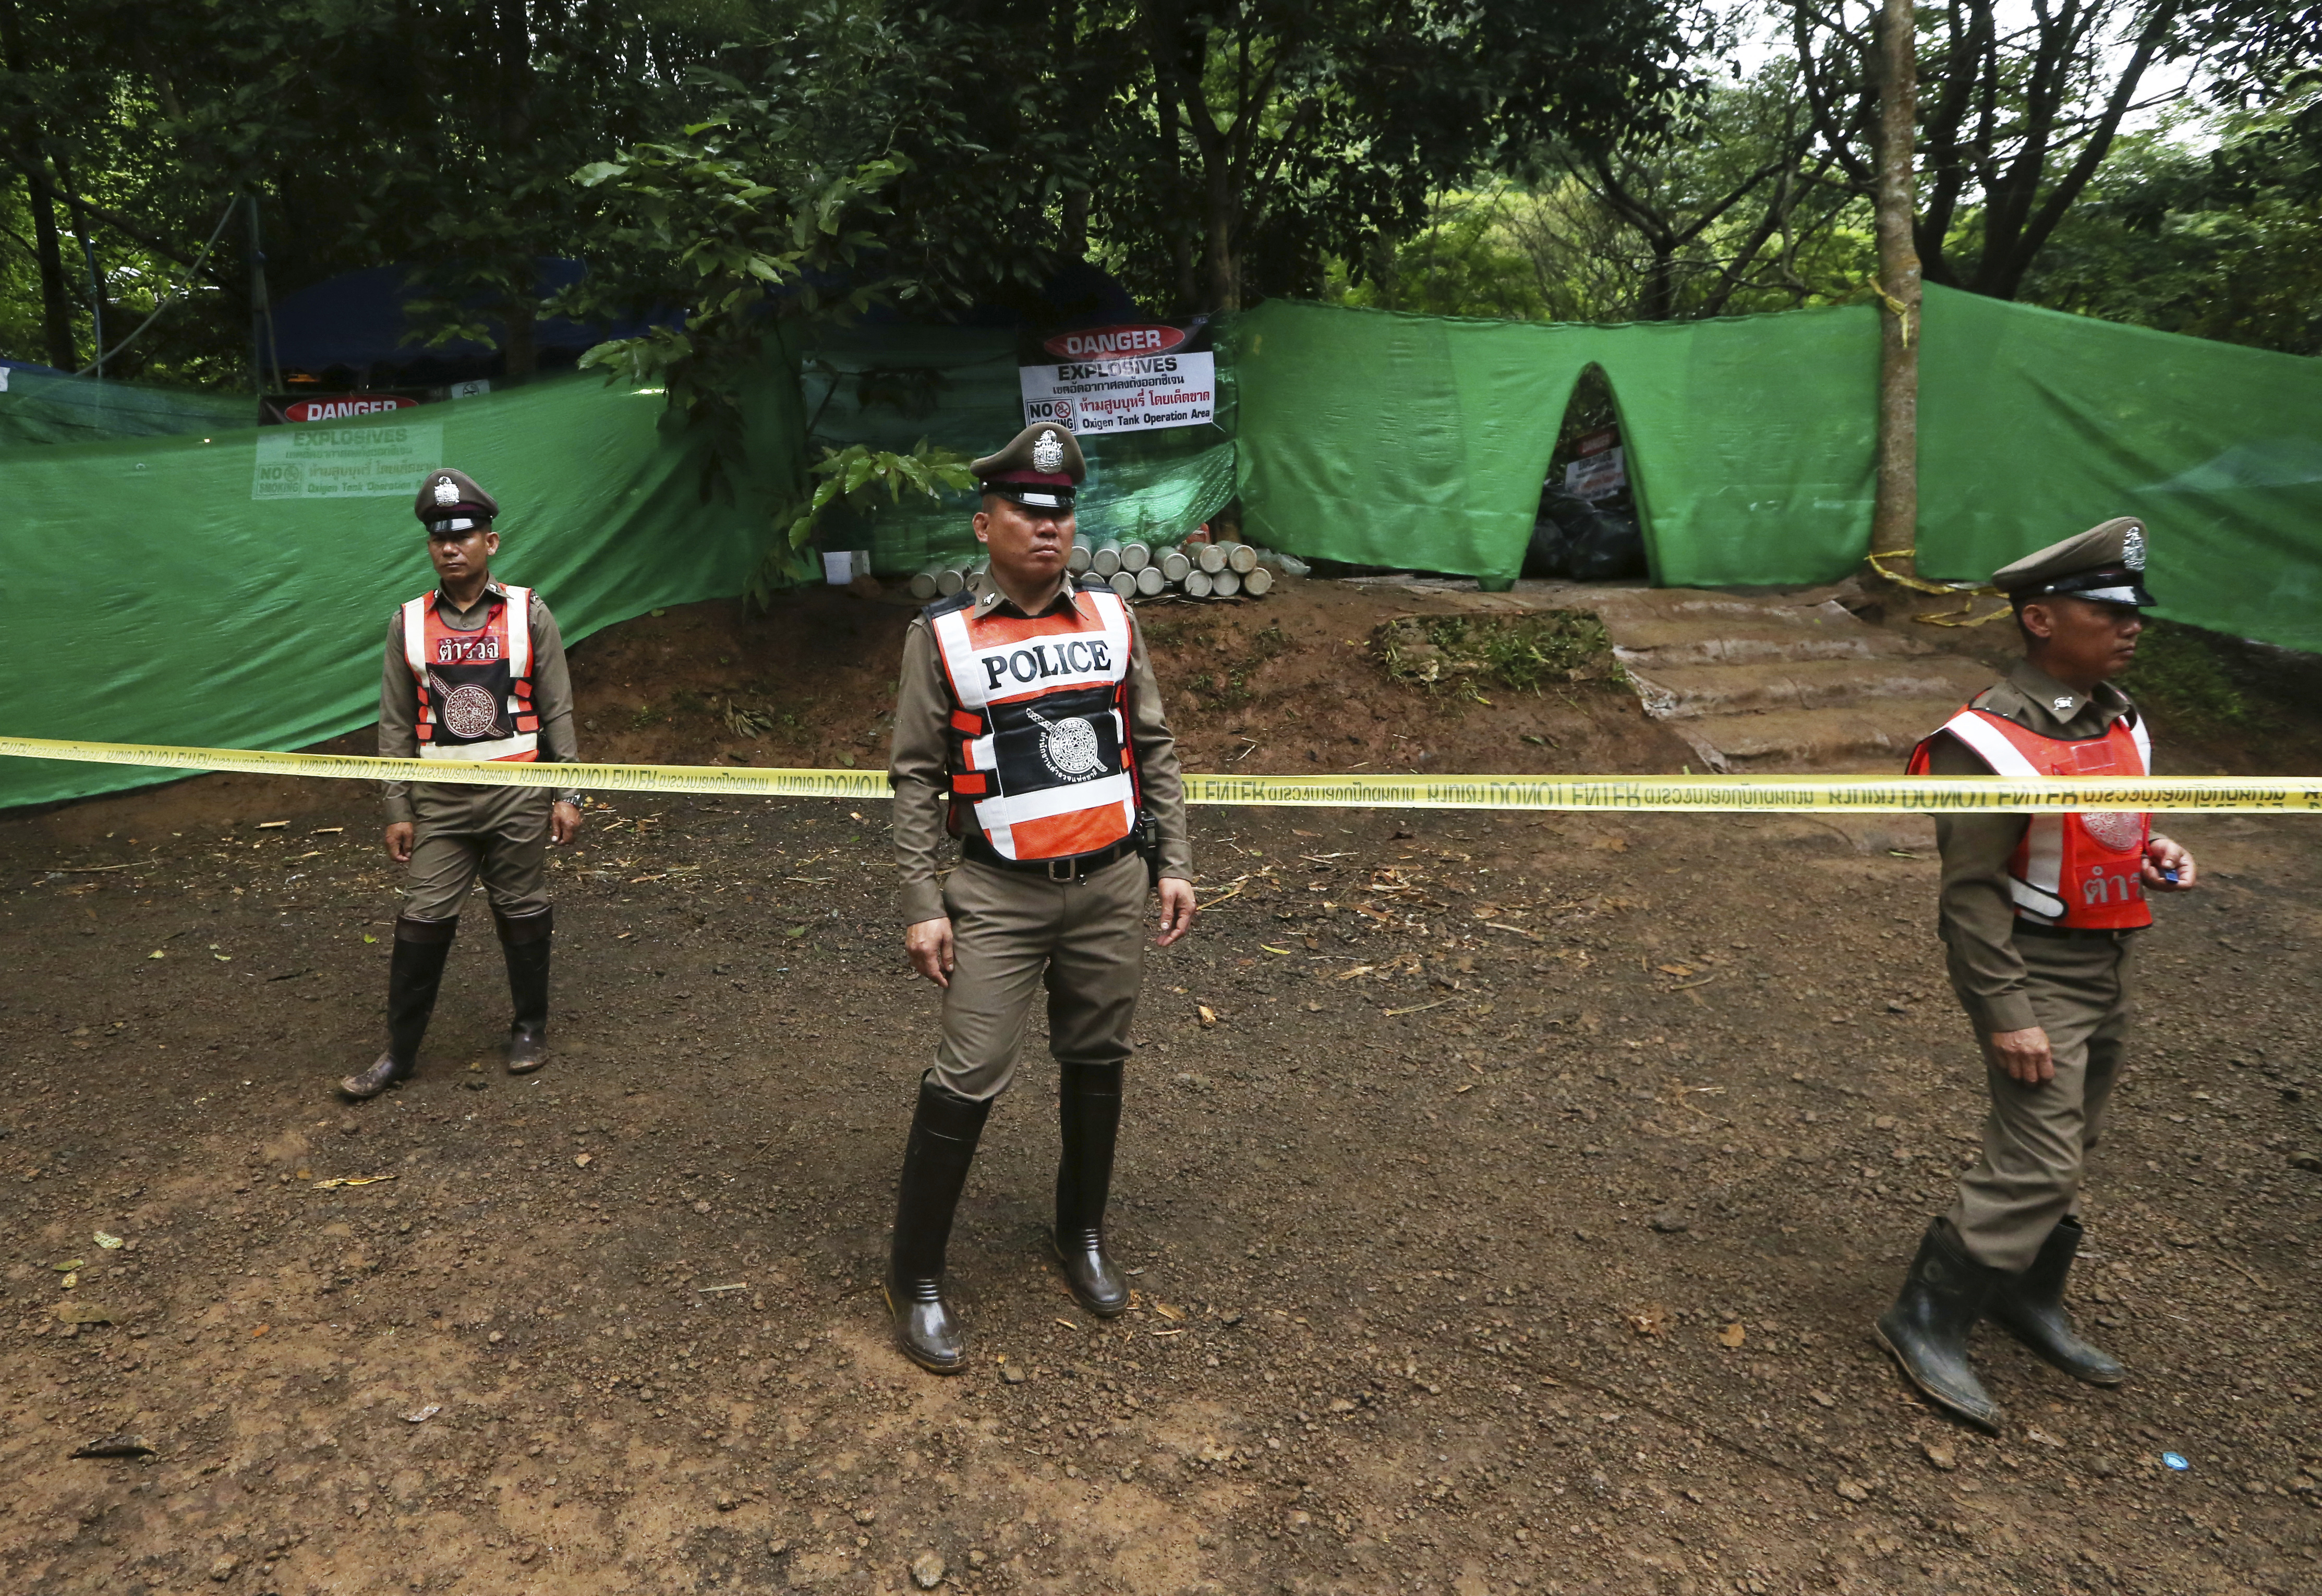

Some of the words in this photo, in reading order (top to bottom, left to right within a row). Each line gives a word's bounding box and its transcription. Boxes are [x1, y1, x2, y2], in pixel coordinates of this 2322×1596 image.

[1067, 330, 1162, 354] DANGER
[1058, 356, 1177, 381] EXPLOSIVES
[307, 401, 397, 421] DANGER
[1030, 403, 1053, 418] NO
[1079, 388, 1145, 414] ห้ามสูบบุหรี่
[1148, 389, 1210, 406] โดยเด็ดขาด
[1083, 418, 1114, 430] Oxigen
[1117, 414, 1140, 426] Tank
[1144, 410, 1187, 425] Operation
[1191, 409, 1210, 419] Area
[294, 428, 407, 446] EXPLOSIVES
[261, 467, 282, 480] NO
[439, 639, 499, 661] ตำรวจ
[982, 640, 1111, 690] POLICE
